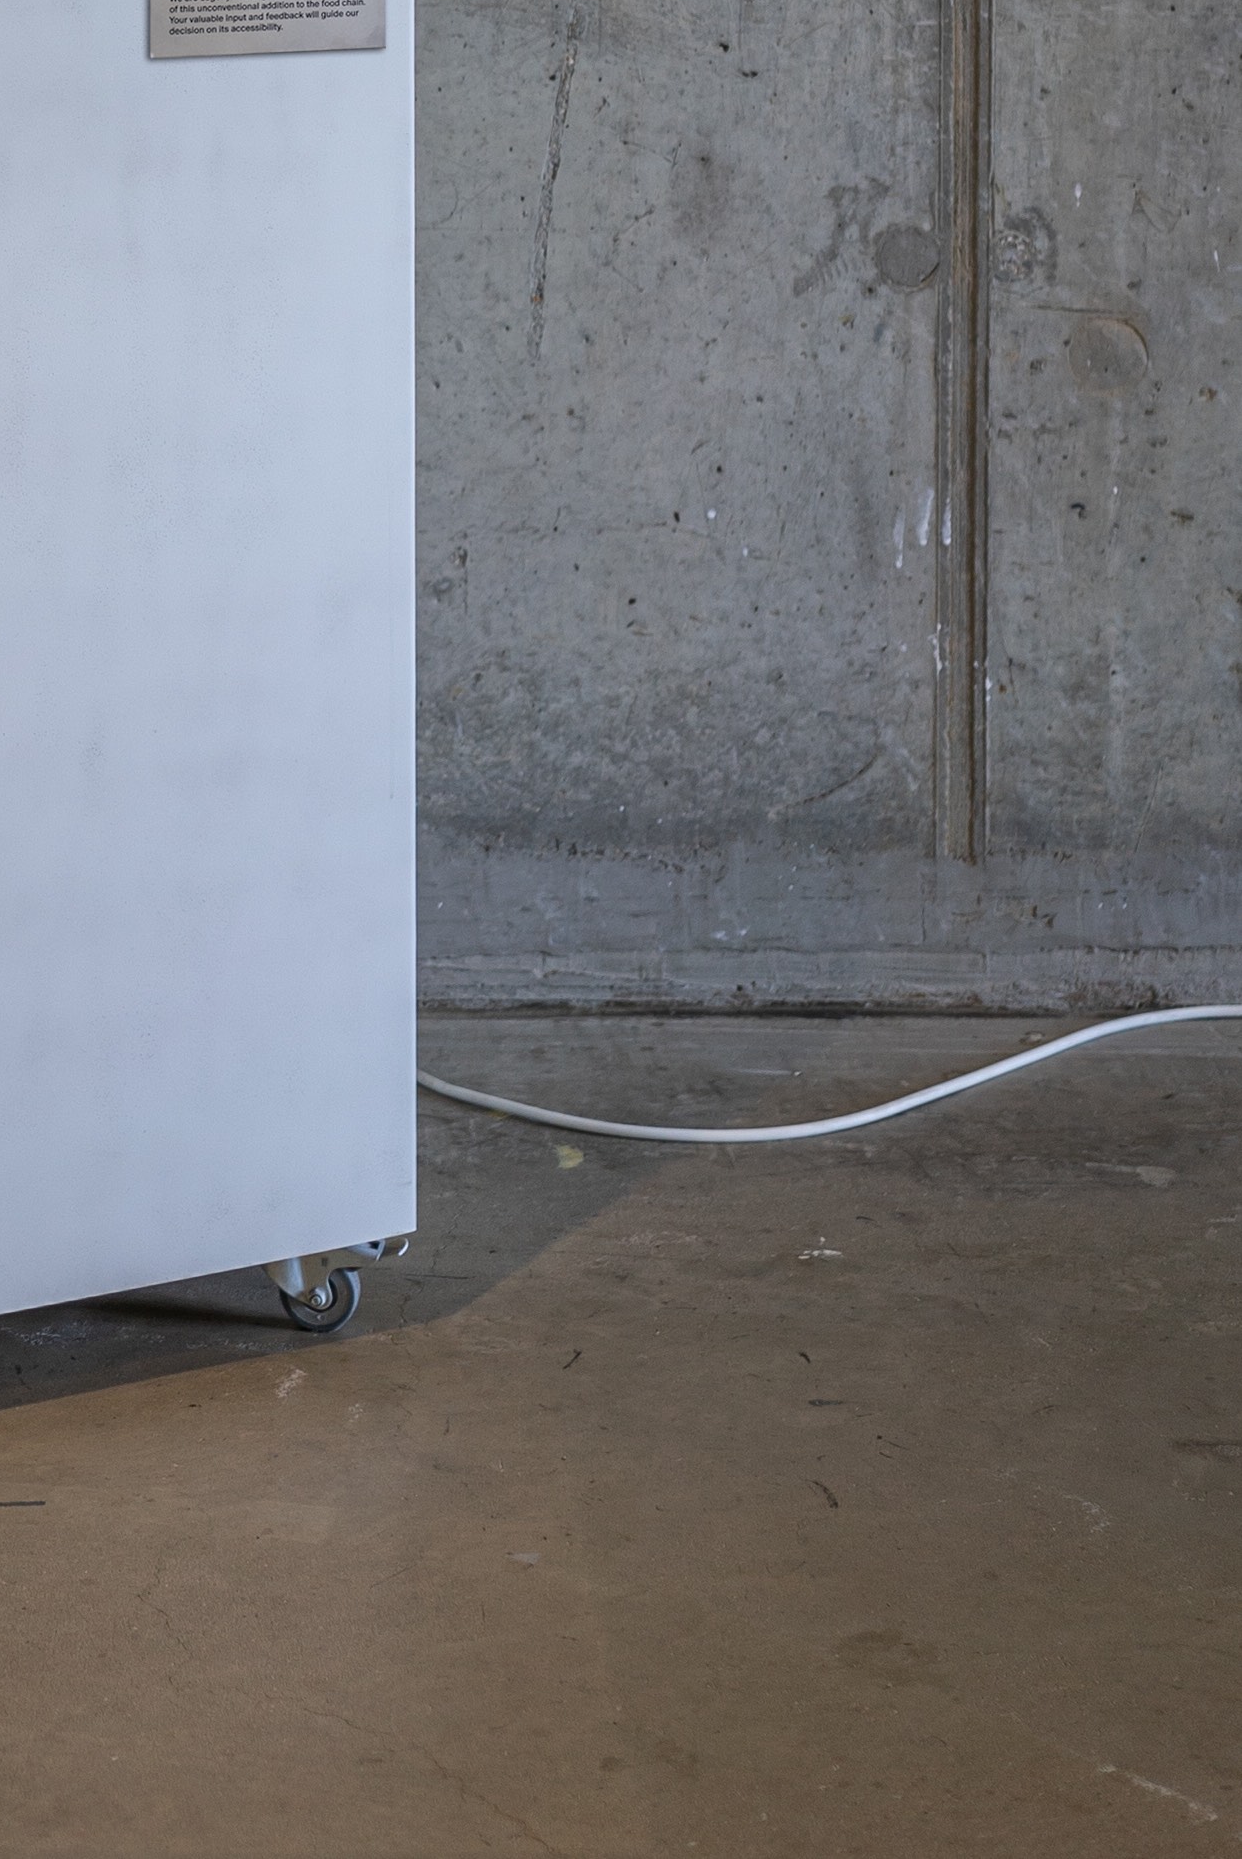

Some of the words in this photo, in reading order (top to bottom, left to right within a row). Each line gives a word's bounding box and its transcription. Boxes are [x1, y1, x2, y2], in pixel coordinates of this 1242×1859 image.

[179, 5, 195, 13] this
[197, 2, 260, 12] unconventional
[261, 1, 295, 10] addition
[306, 0, 320, 8] the
[321, 0, 340, 8] food
[169, 16, 188, 24] Your
[189, 14, 224, 23] valuable
[225, 14, 247, 24] input
[248, 13, 264, 21] and
[265, 11, 304, 20] feedback
[305, 11, 320, 19] will
[320, 10, 344, 20] guide
[169, 26, 205, 35] decision
[231, 23, 283, 34] accessibility.
